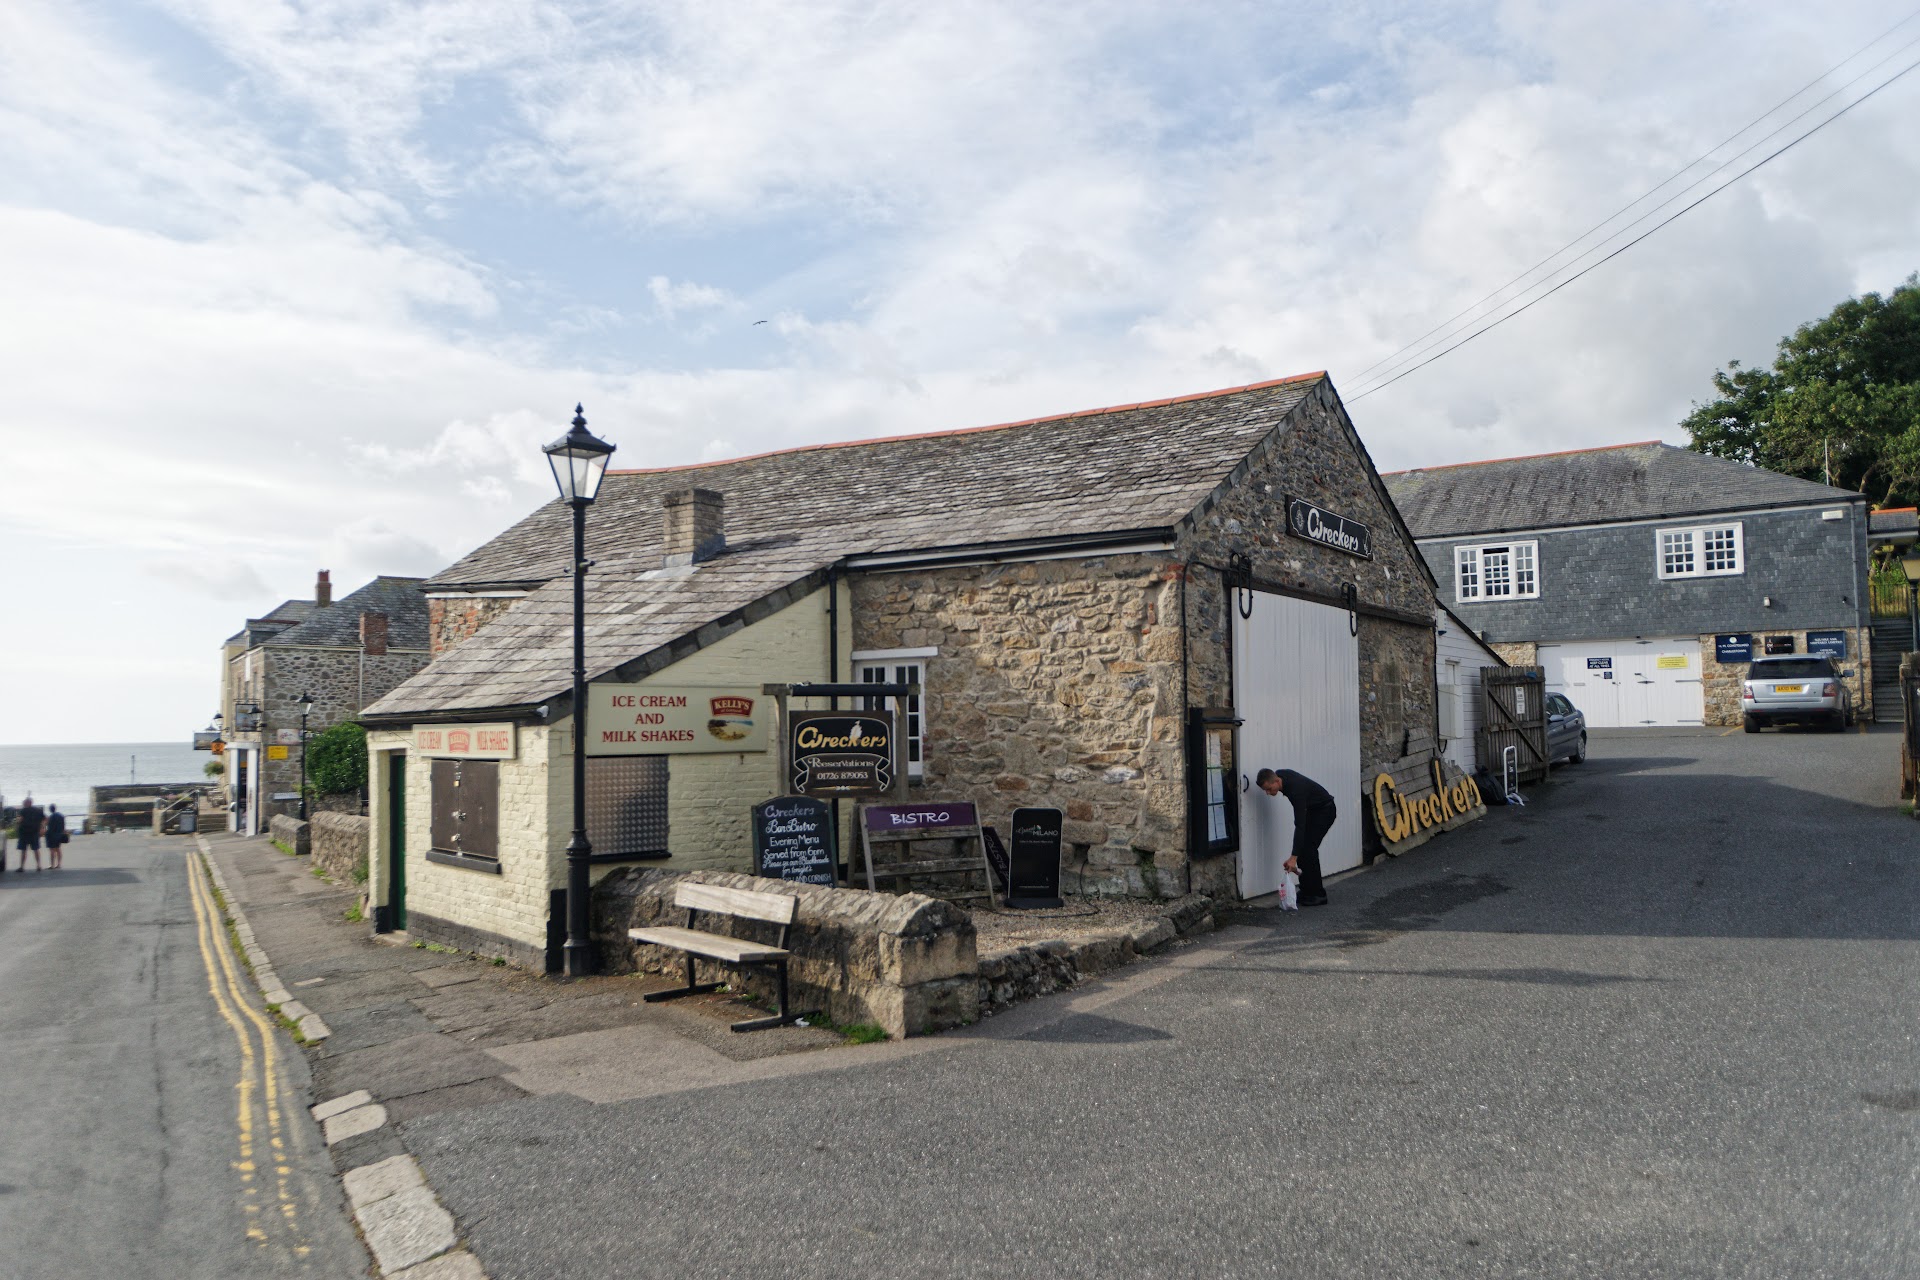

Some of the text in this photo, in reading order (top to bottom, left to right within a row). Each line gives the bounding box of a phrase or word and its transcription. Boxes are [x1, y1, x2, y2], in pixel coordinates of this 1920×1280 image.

[1307, 507, 1359, 551] Wreckers
[612, 695, 687, 707] ICE CREAM
[714, 699, 750, 711] KELLY'S
[635, 713, 665, 725] AND
[418, 731, 427, 750] ICE
[427, 731, 442, 750] CREAM
[477, 730, 509, 751] MILK SHAKES
[602, 730, 694, 743] MILK SHAKES
[797, 724, 887, 749] Wreckers
[817, 772, 839, 780] 01726
[1375, 759, 1483, 843] Wreckers
[765, 803, 815, 818] Wreckers
[765, 817, 819, 834] Bar Bistro
[890, 811, 950, 826] BISTRO
[769, 834, 820, 849] Evening Menu
[763, 845, 825, 860] Served from 6pm
